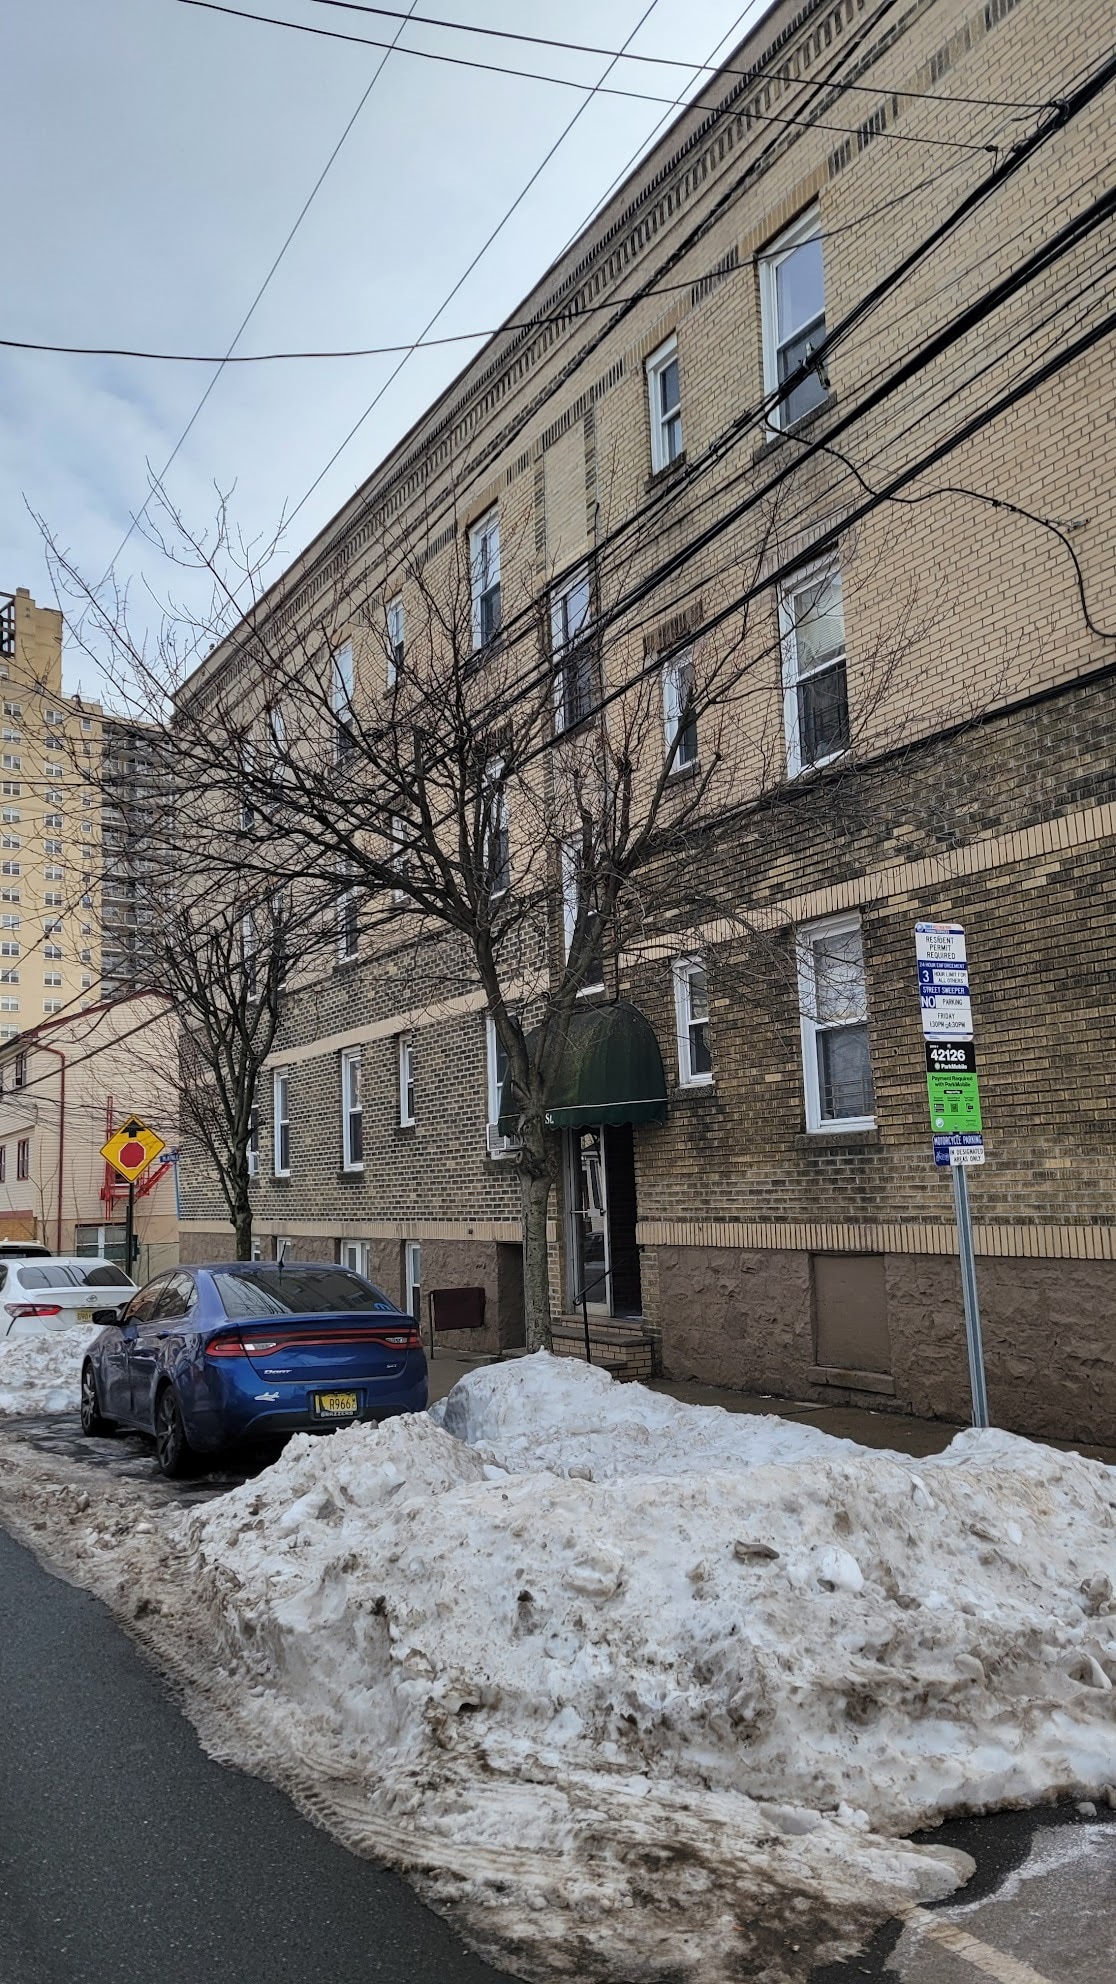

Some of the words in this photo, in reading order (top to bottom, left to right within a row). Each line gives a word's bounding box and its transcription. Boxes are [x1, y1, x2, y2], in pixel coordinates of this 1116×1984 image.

[926, 936, 954, 944] RESIDENT
[929, 943, 951, 952] PERMIT
[922, 970, 930, 983] 3
[922, 986, 940, 994] STREET
[941, 987, 965, 995] SWEEPER
[921, 995, 936, 1008] NO
[942, 998, 963, 1006] PARKING
[937, 1012, 956, 1020] FRIDAY
[931, 1049, 966, 1061] 42126
[934, 1135, 962, 1146] MOTORCYCLE
[962, 1134, 982, 1145] PARKING
[956, 1148, 984, 1156] DESIGNATED
[953, 1155, 969, 1163] AREAS
